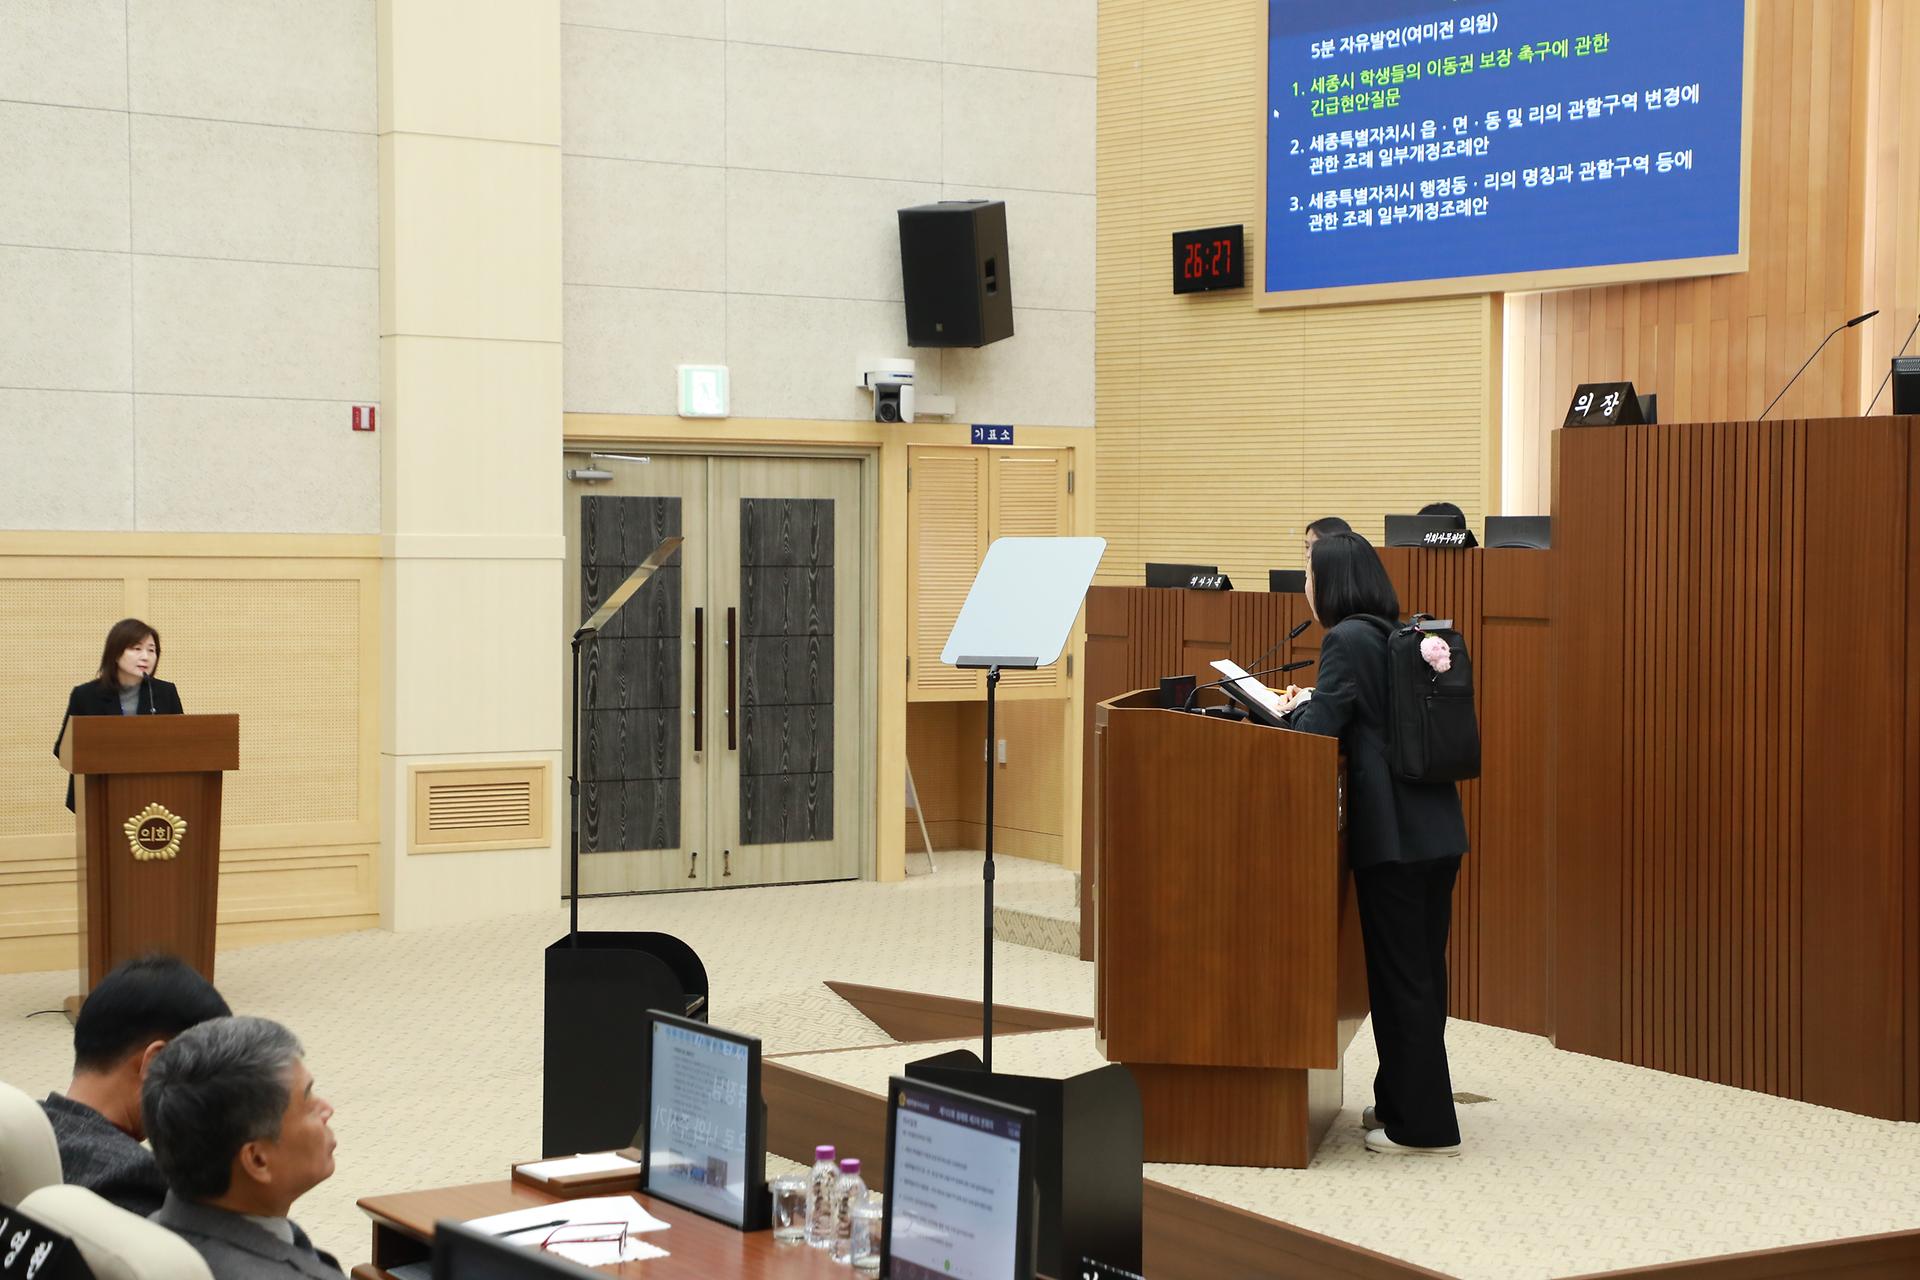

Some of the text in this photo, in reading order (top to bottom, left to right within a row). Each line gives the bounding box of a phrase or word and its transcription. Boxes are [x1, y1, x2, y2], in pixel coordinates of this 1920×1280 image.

[1311, 38, 1335, 59] 5분
[1459, 12, 1498, 35] 의원)
[1292, 32, 1610, 97] 1. 세종시 학생들의 이동권 보장 촉구에 관한
[1289, 139, 1305, 155] 2.
[1309, 121, 1415, 153] 세종특별자치시
[1507, 107, 1523, 128] 및
[1529, 102, 1562, 125] 리의
[1568, 91, 1638, 120] 관할구역
[1645, 83, 1700, 110] 변경에
[1310, 87, 1401, 117] 긴급현안질문
[1309, 135, 1490, 176] 관한 조례 일부개정조례안
[1289, 196, 1304, 211] 3.
[1308, 181, 1414, 210] 세종특별자치시
[1522, 163, 1573, 188] 명칭과
[1578, 154, 1649, 182] 관할구역
[1655, 149, 1693, 173] 등에
[1308, 196, 1489, 232] 관한 조례 일부개정조례안
[1184, 239, 1231, 279] 26:27
[974, 427, 1011, 440] 기표소
[139, 826, 171, 842] 의회
